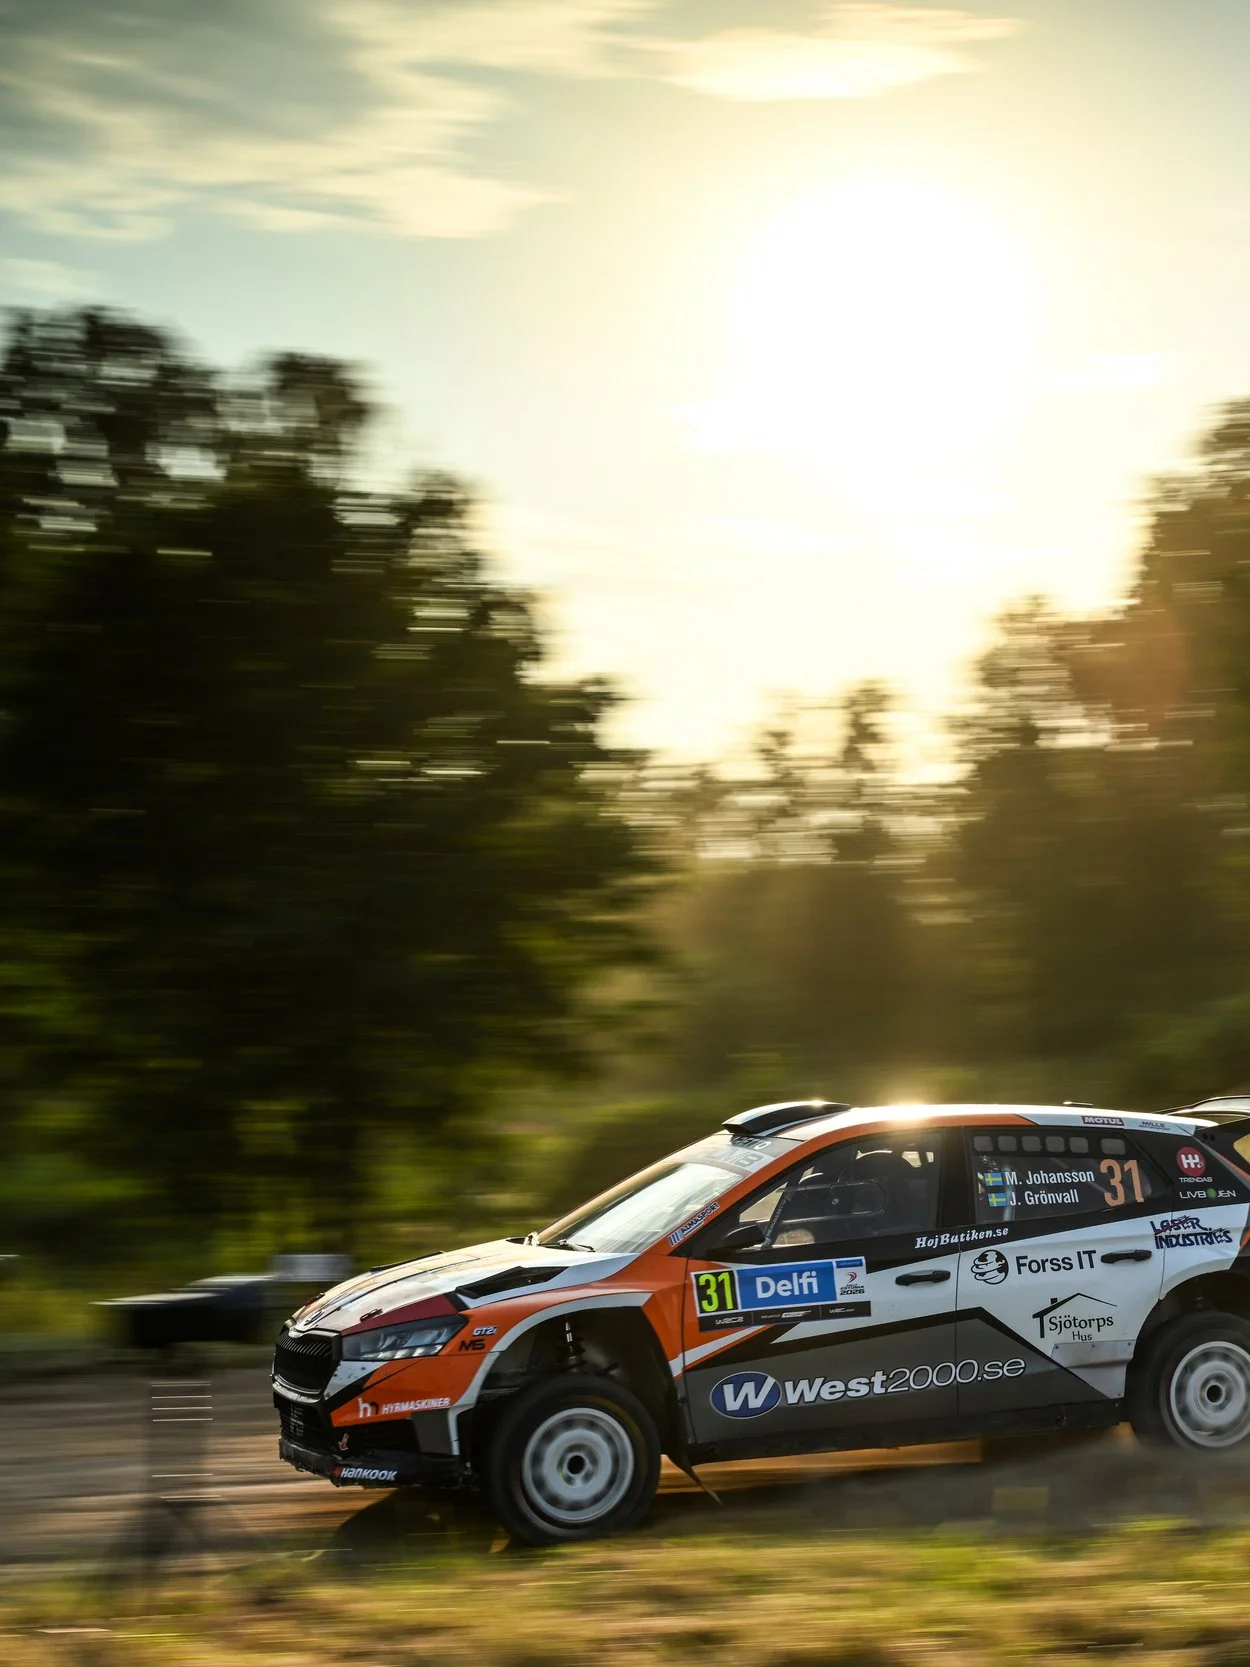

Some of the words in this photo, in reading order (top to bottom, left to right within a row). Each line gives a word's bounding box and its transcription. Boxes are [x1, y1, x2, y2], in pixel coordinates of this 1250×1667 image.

[1084, 1116, 1123, 1125] MOTUL
[1004, 1171, 1022, 1186] M.
[1026, 1170, 1095, 1185] Johansson
[1100, 1159, 1145, 1207] 31
[1009, 1191, 1021, 1206] J.
[1024, 1189, 1080, 1205] Grönvall
[914, 1226, 1009, 1249] HojButiken.se
[1015, 1255, 1074, 1275] Forss
[1076, 1249, 1097, 1270] IT
[699, 1271, 734, 1313] 31
[755, 1270, 819, 1299] Delfi
[1048, 1314, 1114, 1335] Sjötorps
[1072, 1330, 1093, 1341] Hus
[784, 1357, 1027, 1405] West2000.se
[381, 1397, 450, 1415] HYRMASKINER
